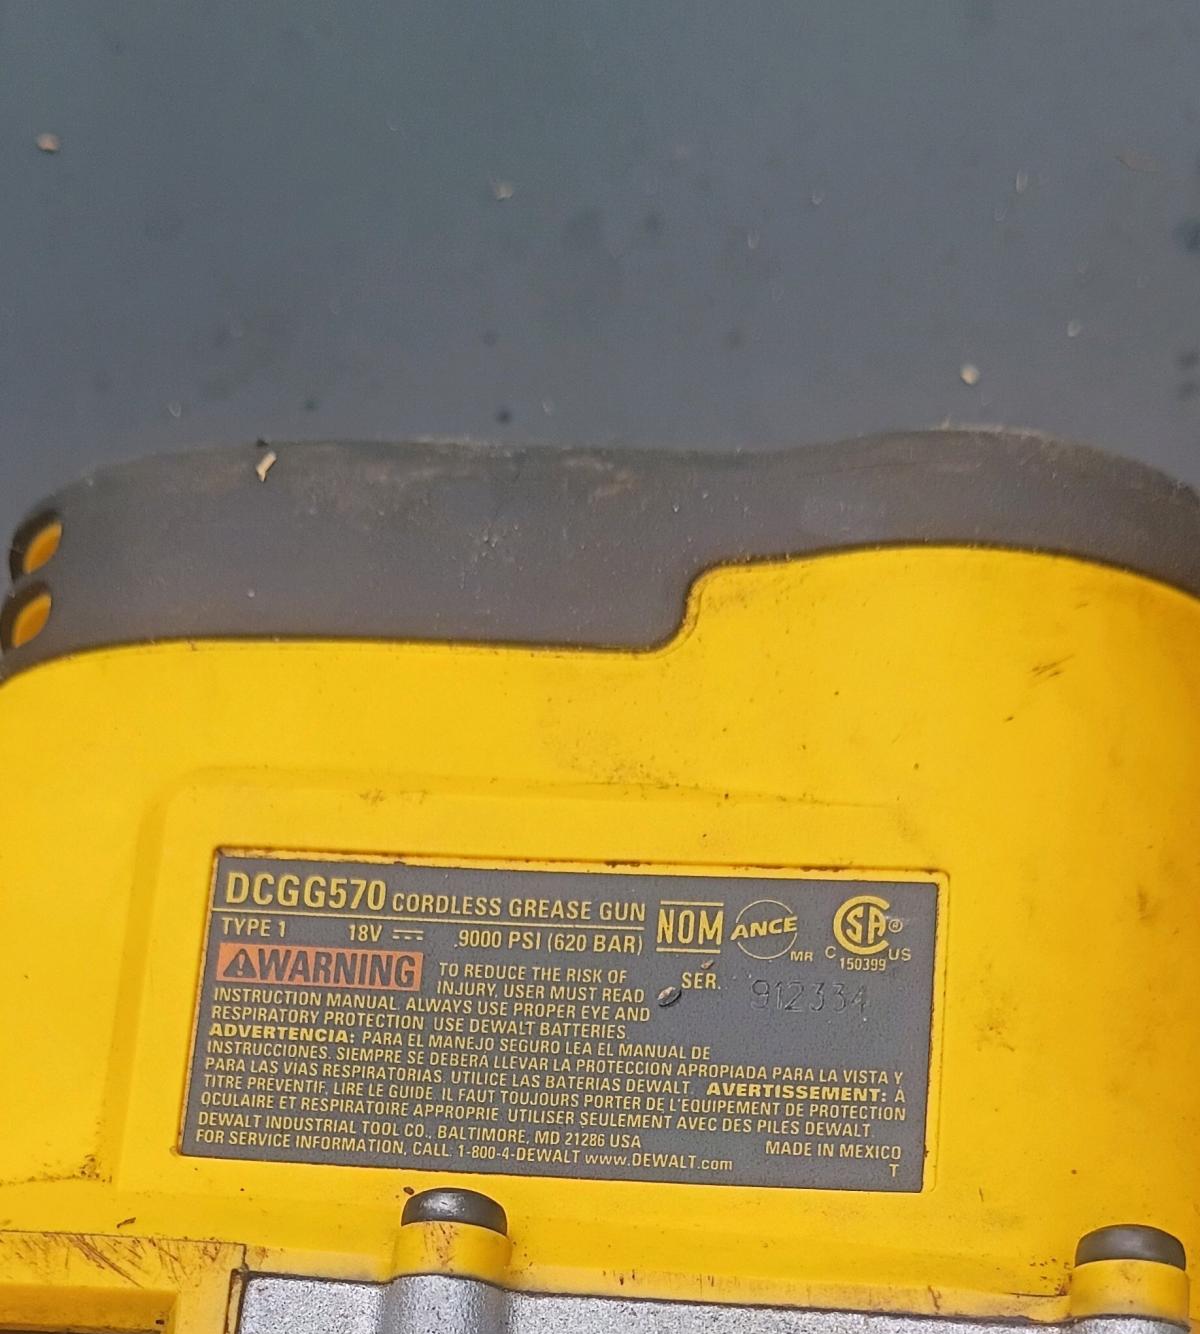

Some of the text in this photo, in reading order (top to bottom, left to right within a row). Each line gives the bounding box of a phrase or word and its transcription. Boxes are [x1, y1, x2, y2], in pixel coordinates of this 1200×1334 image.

[226, 872, 387, 910] DCGG570
[392, 894, 645, 922] CORDLESS GREASE GUN
[222, 919, 286, 938] TYPE 1
[349, 924, 382, 943] 18V
[656, 909, 724, 945] NOM
[730, 915, 798, 940] ANCE
[508, 932, 541, 951] PSI
[547, 934, 586, 953] (620
[594, 936, 643, 956] BAR)
[790, 951, 813, 963] MR
[825, 946, 836, 959] C
[888, 948, 912, 961] US
[257, 949, 415, 988] WARNING
[440, 963, 627, 985] TO REDUCE THE RISK OF
[840, 957, 886, 971] 150399
[437, 981, 644, 1004] INJURY, USER MUST READ
[681, 972, 721, 990] SER.
[214, 988, 321, 1006] INSTRUCTION
[406, 997, 472, 1013] ALWAYS
[478, 1000, 508, 1015] USE
[513, 1002, 575, 1018] PROPER
[582, 1005, 610, 1020] EYE
[615, 1006, 649, 1022] AND
[751, 980, 868, 1013] 912334
[211, 1006, 319, 1024] RESPIRATORY
[434, 1017, 464, 1032] USE
[470, 1018, 535, 1035] DEWALT
[209, 1024, 710, 1061] ADVERTENCIA: PARA EL MANEJO SEGURO LEA EL MANUAL DE
[208, 1041, 331, 1059] INSTRUCCIONES.
[336, 1047, 402, 1063] SIEMPRE
[407, 1050, 424, 1064] SE
[494, 1054, 548, 1069] LLEVAR
[553, 1056, 571, 1070] LA
[576, 1057, 672, 1075] PROTECCION
[677, 1062, 767, 1079] APROPIADA
[772, 1066, 814, 1081] PARA
[820, 1068, 838, 1082] LA
[844, 1069, 889, 1084] VISTA
[895, 1072, 903, 1085] Y
[205, 1058, 245, 1073] PARA
[250, 1060, 278, 1074] LAS
[451, 1069, 507, 1085] UTILICE
[512, 1072, 540, 1086] LAS
[545, 1074, 621, 1090] BATERIAS
[707, 1081, 887, 1102] AVERTISSEMENT:
[205, 1075, 242, 1089] TITRE
[334, 1081, 364, 1095] LIRE
[368, 1083, 384, 1096] LE
[442, 1087, 453, 1099] IL
[458, 1087, 496, 1101] FAUT
[501, 1089, 579, 1105] TOUJOURS
[584, 1093, 641, 1108] PORTER
[646, 1096, 664, 1109] DE
[785, 1103, 804, 1116] DE
[809, 1104, 906, 1121] PROTECTION
[201, 1092, 274, 1109] OCULAIRE
[280, 1096, 297, 1110] ET
[301, 1097, 409, 1115] RESPIRATOIRE
[508, 1107, 574, 1123] UTILISER
[580, 1111, 672, 1128] SEULEMENT
[677, 1115, 717, 1130] AVEC
[722, 1118, 752, 1132] DES
[757, 1119, 800, 1135] PILES
[199, 1112, 262, 1128] DEWALT
[266, 1116, 356, 1134] INDUSTRIAL
[362, 1121, 400, 1136] TOOL
[438, 1125, 530, 1143] BALTIMORE,
[534, 1130, 560, 1145] MD
[565, 1132, 605, 1147] 21286
[610, 1134, 641, 1149] USA
[196, 1130, 225, 1145] FOR
[229, 1132, 291, 1148] SERVICE
[296, 1135, 407, 1154] INFORMATION,
[458, 1144, 580, 1163] 1-800-4-DEWALT
[585, 1152, 734, 1170] www.DEWALT.com
[766, 1141, 901, 1160] MADE IN MEXICO
[889, 1164, 900, 1178] T
